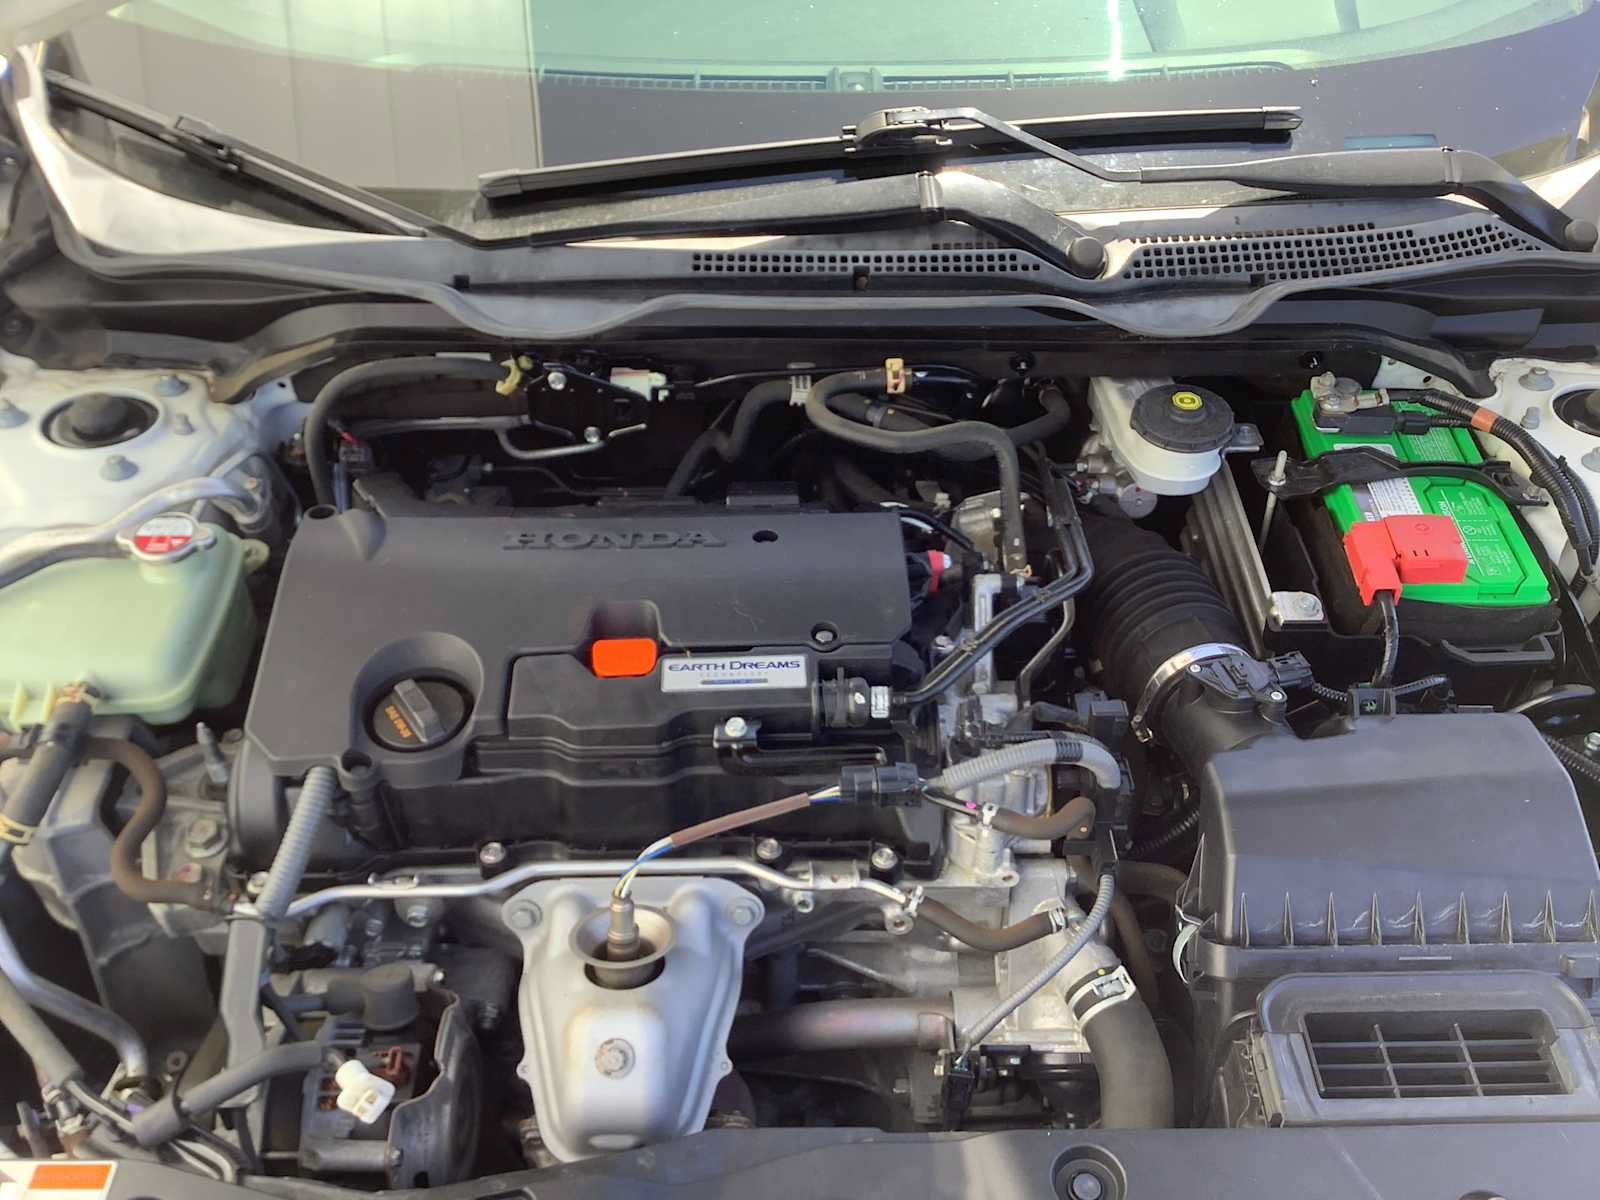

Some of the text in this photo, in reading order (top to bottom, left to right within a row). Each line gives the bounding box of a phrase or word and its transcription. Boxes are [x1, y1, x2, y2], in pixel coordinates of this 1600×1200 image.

[503, 528, 727, 550] HONDA
[668, 660, 801, 672] EARTH DREAMS
